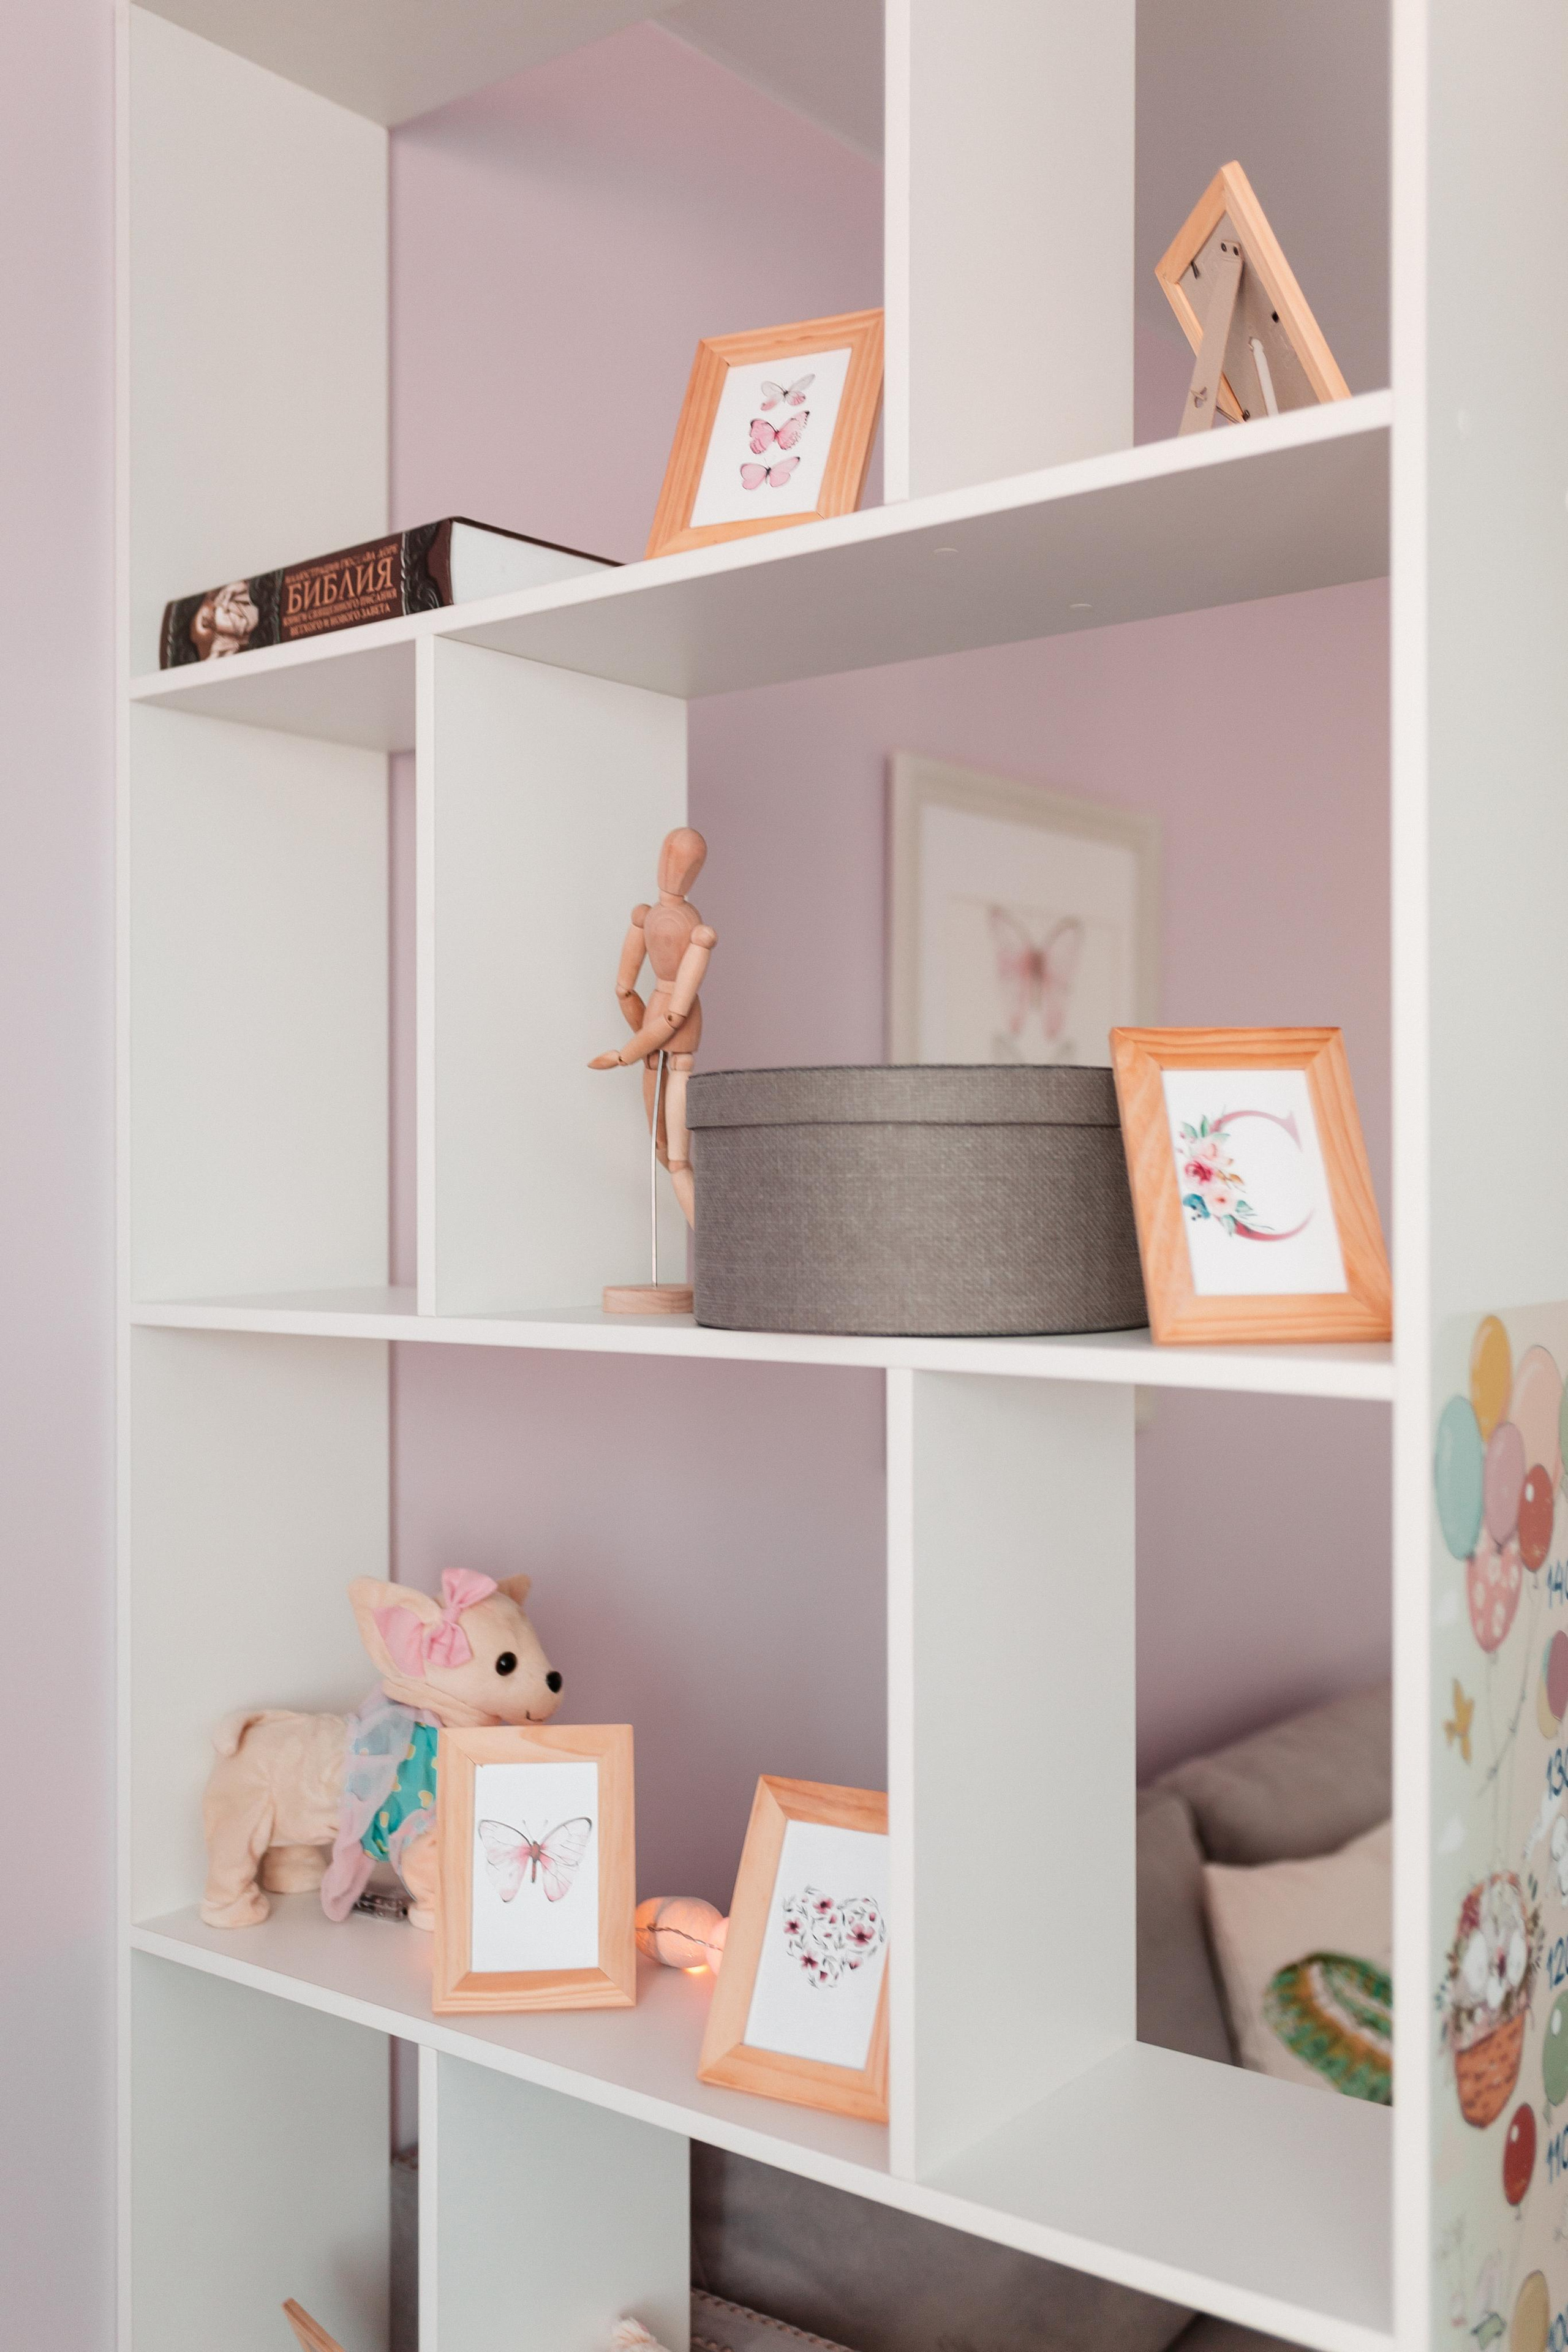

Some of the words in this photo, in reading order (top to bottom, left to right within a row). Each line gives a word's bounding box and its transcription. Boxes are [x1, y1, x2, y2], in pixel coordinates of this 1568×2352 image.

[287, 556, 394, 615] БИБЛИЯ
[1547, 1559, 1568, 1609] 14
[1546, 1747, 1568, 1801] 13
[1546, 1934, 1568, 1992] 12
